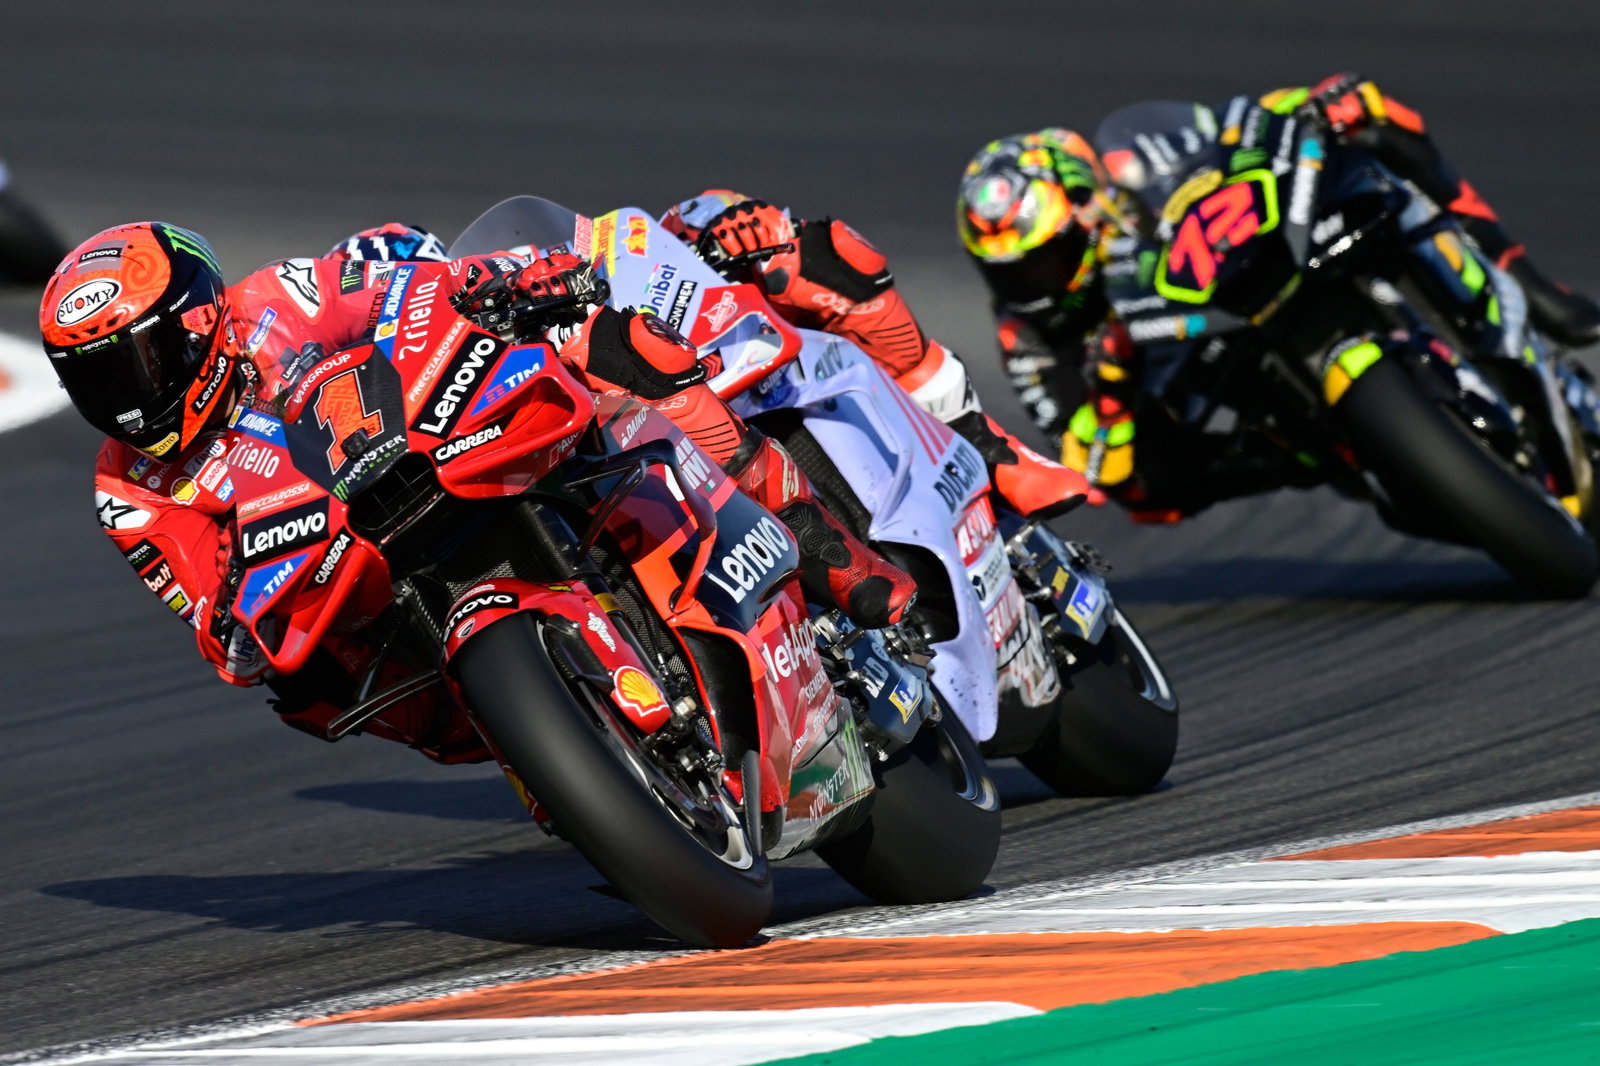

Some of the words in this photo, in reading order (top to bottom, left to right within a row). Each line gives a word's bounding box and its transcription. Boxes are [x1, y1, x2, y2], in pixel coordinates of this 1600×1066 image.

[81, 249, 118, 260] Lenovo
[59, 285, 114, 317] SUOMY
[385, 268, 412, 317] ADVANCE
[640, 264, 677, 315] Unibat
[195, 356, 227, 409] Lenovo
[409, 321, 465, 402] FRECCIAROSSA
[505, 362, 541, 389] TIM
[420, 339, 496, 434] Lenovo
[238, 412, 280, 437] ADVANCE
[313, 368, 384, 475] 1
[436, 425, 502, 460] CARRERA
[345, 434, 406, 484] MONSTER
[933, 442, 983, 514] DUCATI
[239, 483, 310, 514] FRECCIAROSSA
[242, 512, 326, 558] Lenovo
[315, 533, 350, 584] CARRERA
[264, 561, 294, 594] TIM
[708, 517, 789, 604] Lenovo
[444, 594, 513, 643] enovo
[809, 758, 850, 824] MONSTER
